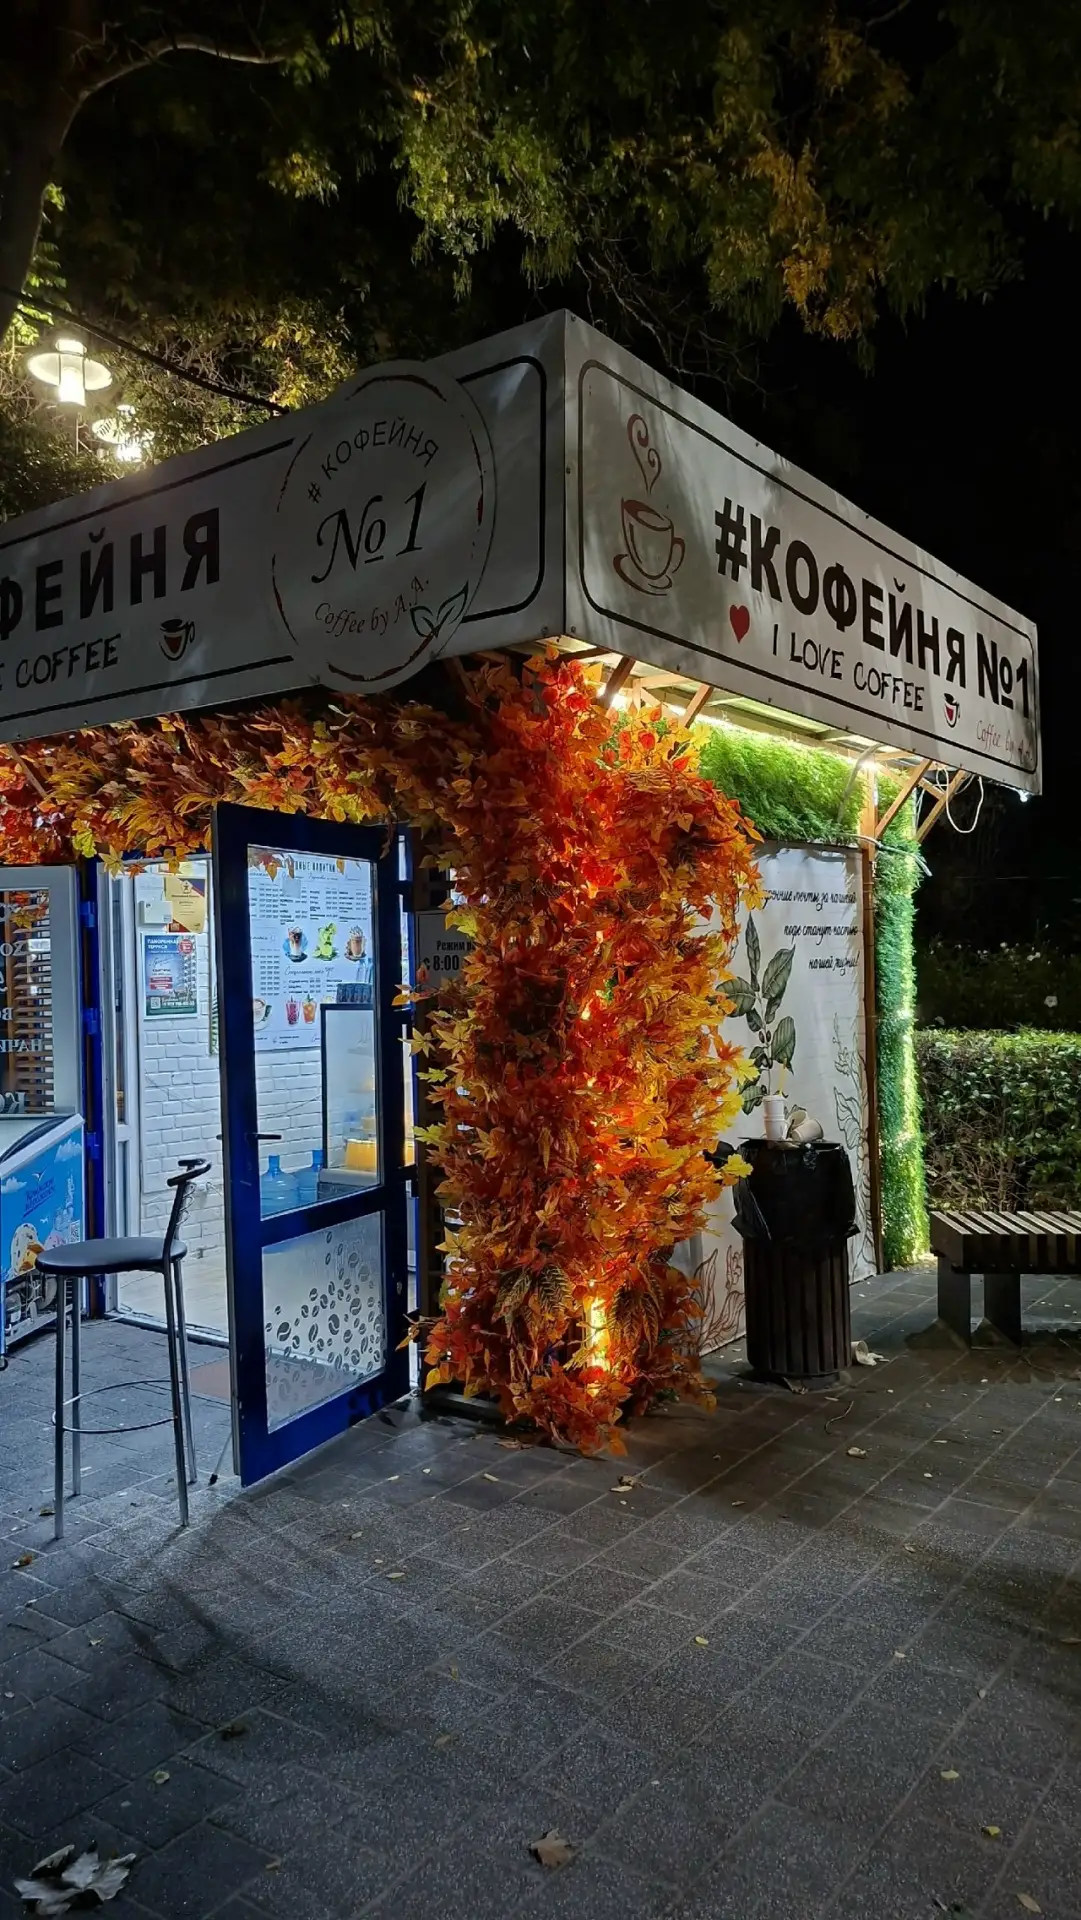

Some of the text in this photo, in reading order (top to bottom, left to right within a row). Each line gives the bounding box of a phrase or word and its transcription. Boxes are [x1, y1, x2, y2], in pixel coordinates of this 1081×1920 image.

[315, 602, 365, 637] Coffee
[371, 607, 389, 635] by
[16, 633, 121, 689] COFFEE
[772, 623, 925, 712] I LOVE COFFEE
[976, 632, 1029, 719] №1
[433, 955, 460, 971] 8:00
[436, 940, 465, 951] Режим
